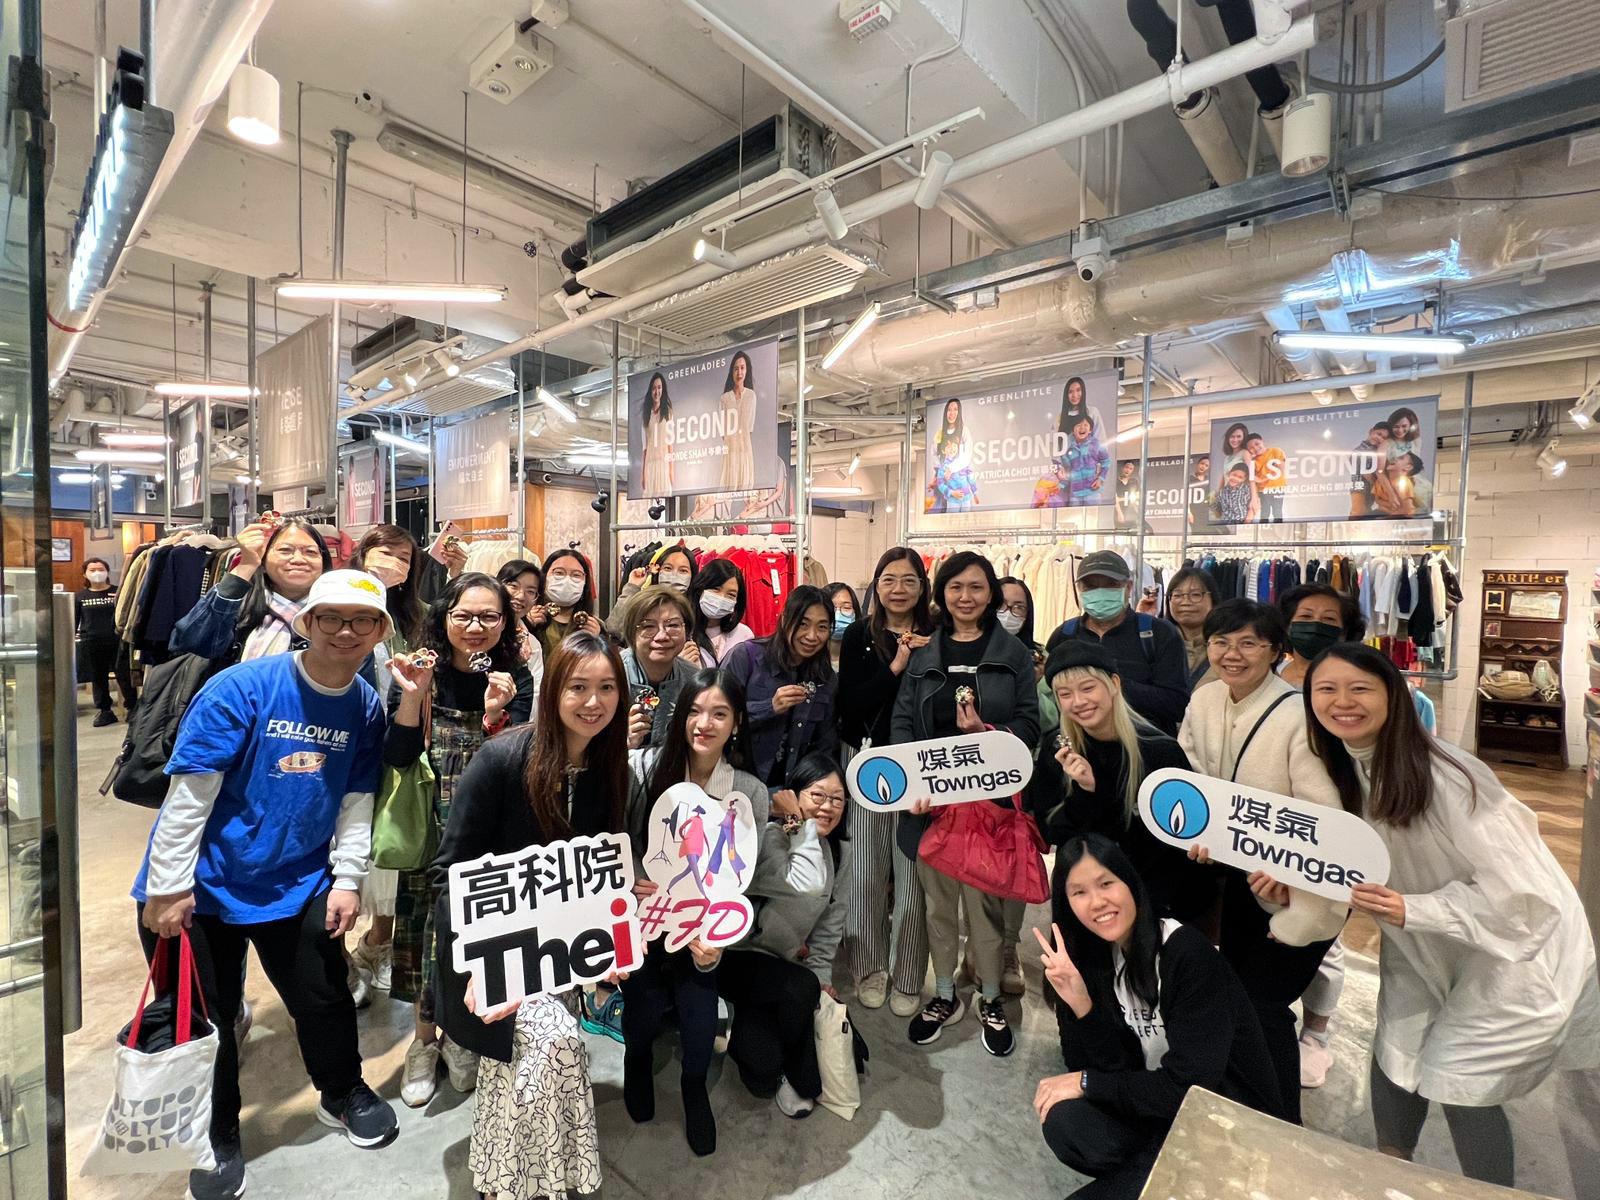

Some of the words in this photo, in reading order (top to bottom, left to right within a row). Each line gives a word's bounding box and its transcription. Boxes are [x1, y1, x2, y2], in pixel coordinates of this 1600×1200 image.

[668, 358, 726, 380] GREENLADIES
[978, 386, 1053, 405] GREENLITTLE
[1273, 409, 1360, 425] GREENLITTLE
[653, 422, 658, 447] I
[1300, 482, 1333, 492] CHENG
[266, 719, 332, 740] FOLLOW
[331, 729, 350, 744] ME
[917, 743, 985, 773] 煤氣
[921, 769, 1022, 794] Towngas
[1228, 794, 1319, 846] 煤氣
[1227, 826, 1365, 888] Towngas
[460, 839, 626, 925] 高科院
